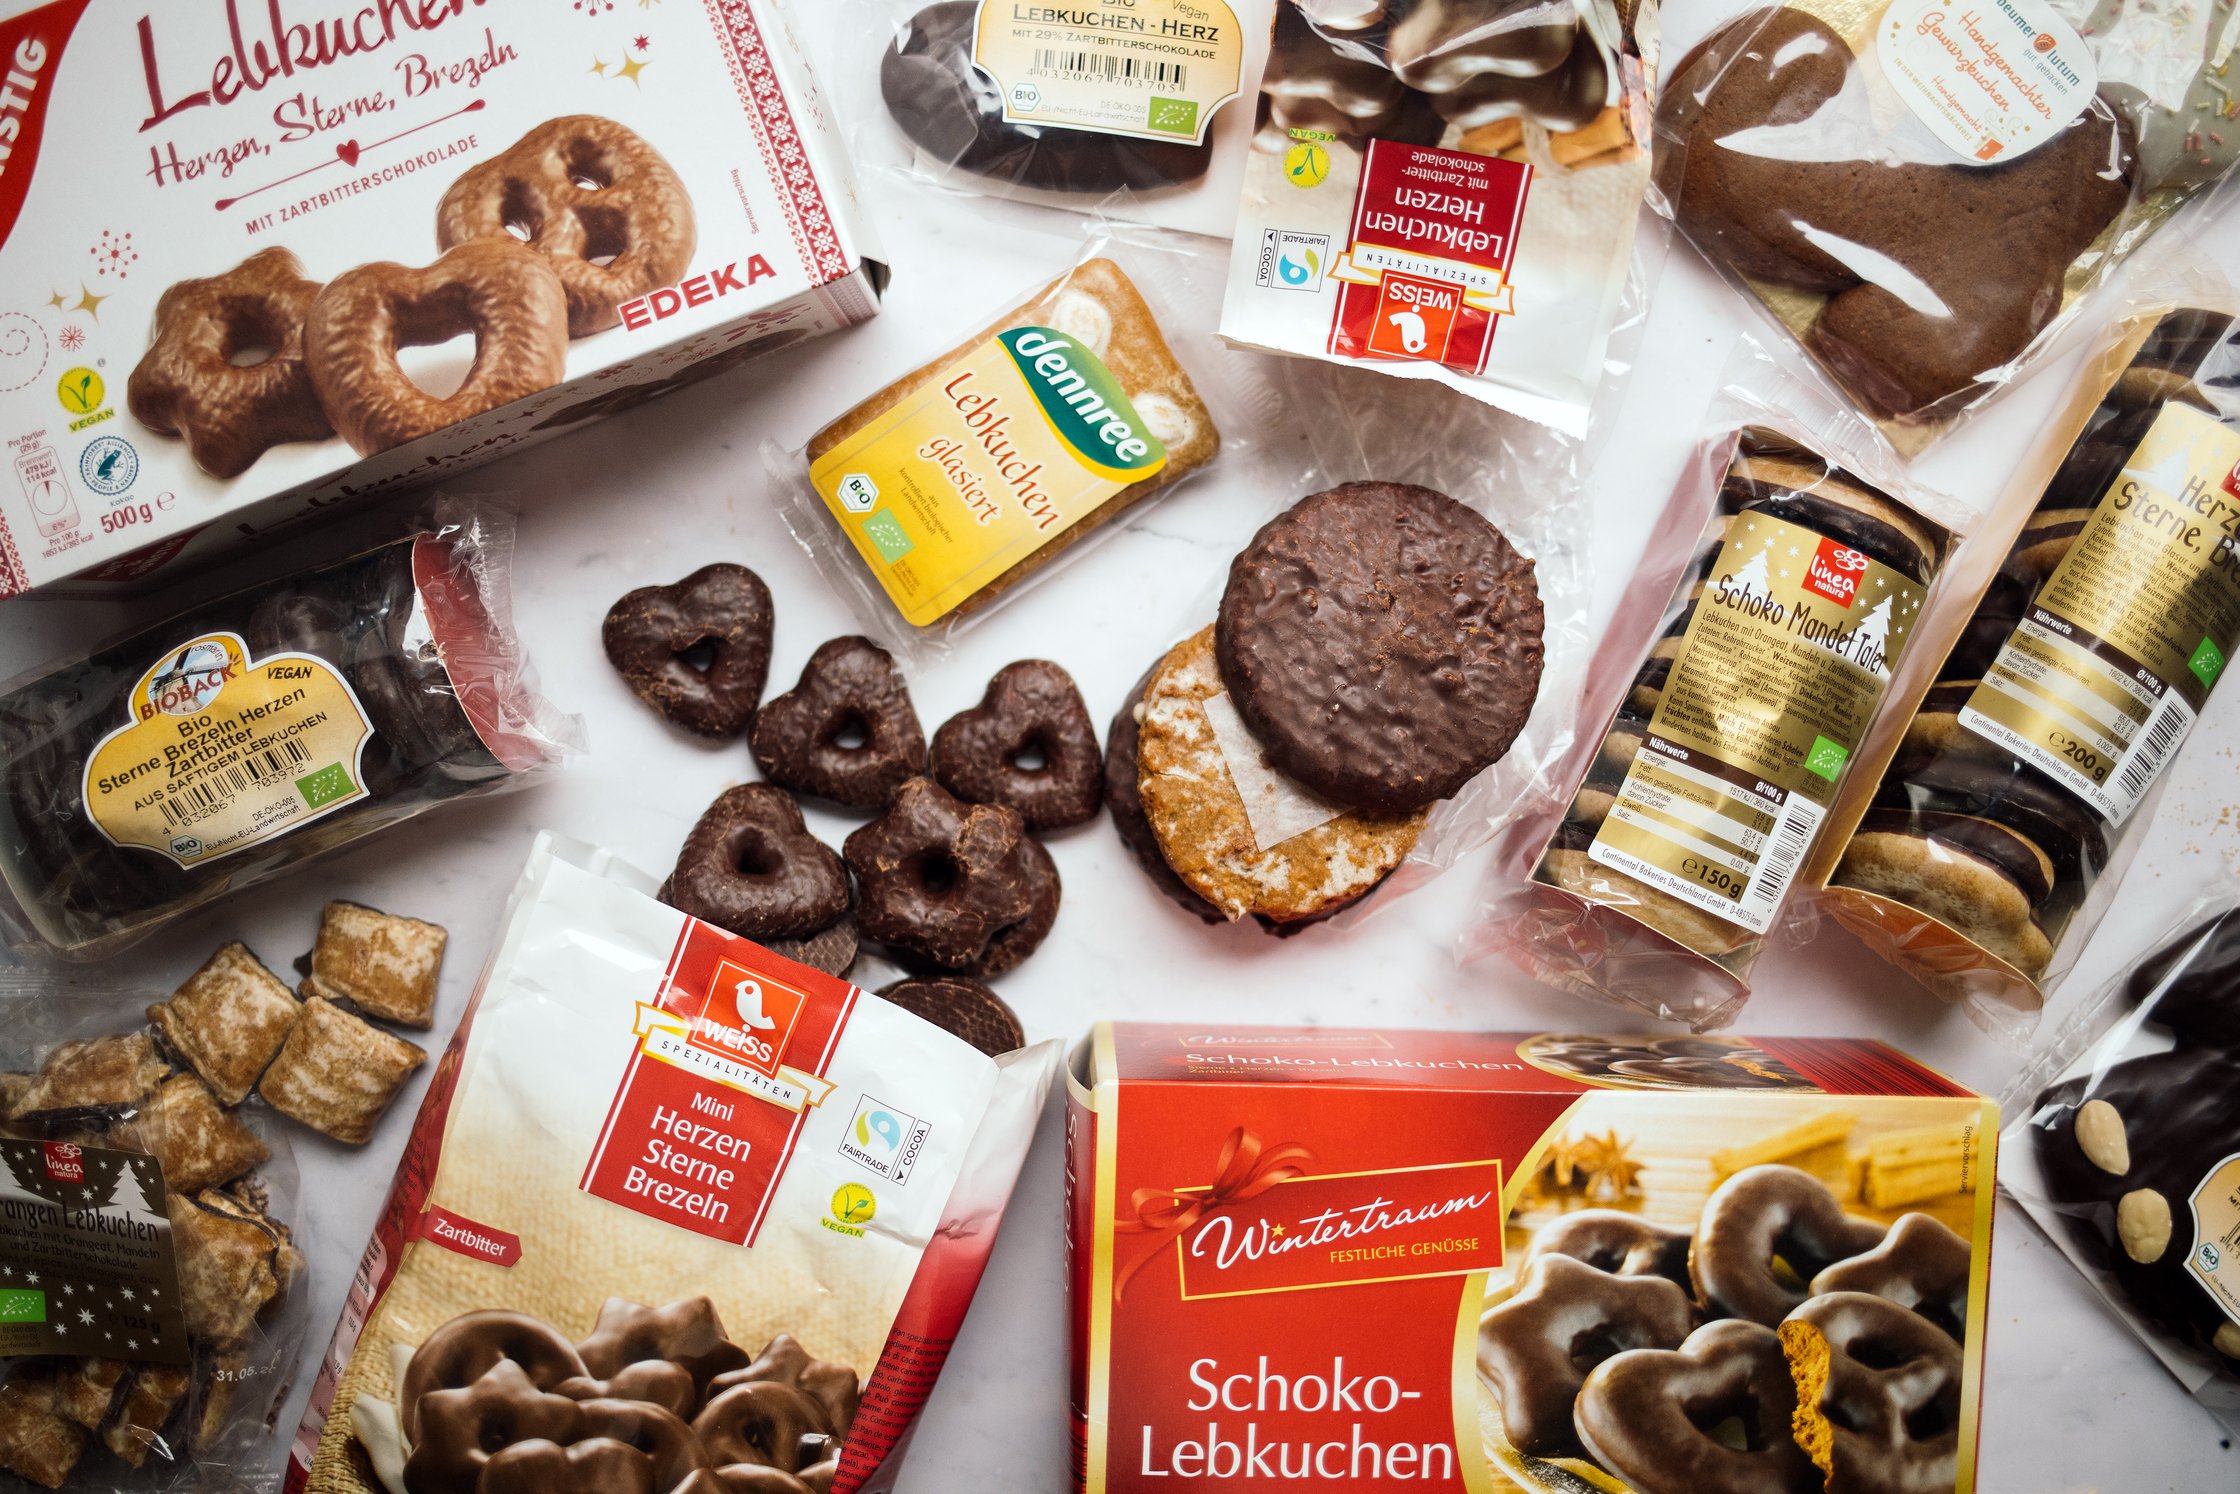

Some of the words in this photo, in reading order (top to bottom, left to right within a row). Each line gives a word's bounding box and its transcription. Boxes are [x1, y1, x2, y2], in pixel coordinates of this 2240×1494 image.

[1172, 0, 1210, 22] Vegan
[1036, 29, 1063, 40] 29%
[1997, 0, 2036, 39] beumer
[2046, 50, 2081, 87] lutum
[1916, 12, 2010, 112] Gewürzkuchen
[1958, 11, 2053, 120] Handgemachter
[2021, 47, 2038, 63] gut
[2035, 61, 2069, 96] gebacken
[1040, 69, 1103, 83] 032067
[1115, 77, 1175, 93] 703705
[146, 142, 271, 186] Herzen,
[274, 93, 395, 142] Sterne,
[396, 28, 518, 97] Brezeln
[1931, 75, 1984, 133] Handgemacht
[1289, 128, 1336, 142] VEGAN
[1401, 167, 1463, 188] Zartbitter-
[1411, 152, 1485, 173] schokolade
[246, 213, 274, 235] MIT
[280, 135, 479, 222] ZARTBITTERSCHOKOLADE
[731, 169, 759, 234] Serviervorschlag
[1468, 176, 1489, 191] mit
[1395, 187, 1485, 224] Herzen
[1282, 234, 1326, 245] FAIRTRADE
[1365, 210, 1503, 258] Lebkuchen
[1259, 246, 1272, 281] COCOA
[1367, 253, 1486, 285] SPEZIALITÄTEN
[617, 253, 778, 331] EDEKA
[1015, 332, 1148, 462] dennree
[70, 408, 115, 432] VEGAN
[8, 439, 19, 448] Pro
[21, 430, 47, 443] Portion
[944, 371, 1059, 530] Lebkuchen
[19, 451, 52, 468] Brennwert
[26, 464, 39, 474] 479
[27, 473, 40, 483] 114
[42, 467, 57, 478] kcal
[85, 441, 105, 476] RAINFOREST
[107, 441, 134, 460] ALLIANCE
[920, 436, 999, 524] glasiert
[101, 506, 137, 534] 500
[139, 503, 153, 523] g
[110, 495, 134, 507] Kakao
[898, 467, 927, 505] kontrolliert
[923, 503, 954, 544] biologischer
[899, 486, 936, 536] Landwirtschaft
[928, 494, 939, 507] aus
[2114, 481, 2202, 553] Sterne,
[2100, 511, 2145, 543] Lebkuchen
[2160, 543, 2190, 566] Glasur
[1810, 555, 1855, 594] linea
[1814, 578, 1845, 599] natura
[1701, 606, 1741, 635] Lebkuchen
[1739, 624, 1754, 638] mit
[1752, 628, 1790, 655] Orangeat,
[1789, 642, 1822, 666] Mandeln
[1714, 574, 1784, 625] Schoko
[1787, 602, 1856, 657] Mandel
[1856, 633, 1888, 675] Taler
[2032, 608, 2073, 636] Nährwerte
[2006, 648, 2049, 677] Kohlenhydrate:
[2013, 639, 2032, 654] davon
[2024, 622, 2049, 640] Energie:
[2107, 667, 2124, 682] 1602
[267, 666, 312, 680] VEGAN
[2002, 656, 2021, 671] davon
[2018, 664, 2042, 682] Zucker:
[140, 663, 238, 721] BIOBACK
[1686, 687, 1720, 709] kontrolliert
[177, 714, 212, 738] Bio
[1661, 717, 1691, 736] Mindestens
[1663, 703, 1692, 723] früchten
[99, 755, 161, 795] Sterne
[164, 716, 236, 763] Brezeln
[238, 687, 306, 725] Herzen
[166, 726, 253, 778] Zartbitter
[1647, 736, 1689, 762] Nährwerte
[1969, 713, 2006, 739] Continental
[2002, 731, 2033, 754] Bakeries
[2029, 747, 2072, 779] Deutschland
[2067, 772, 2089, 791] GmbH
[134, 790, 164, 811] AUS
[168, 751, 241, 794] SAFTIGEM
[245, 711, 327, 756] LEBKUCHEN
[1642, 751, 1668, 769] Energie:
[1728, 786, 1743, 798] 1517
[2060, 738, 2100, 771] 200
[2090, 763, 2108, 783] g
[162, 826, 171, 835] 4
[182, 794, 236, 827] 032067
[252, 763, 306, 790] 703972
[1626, 788, 1645, 802] davon
[1644, 795, 1666, 811] Zucker:
[1629, 779, 1673, 805] Kohlenhydrate:
[1635, 769, 1655, 783] davon
[1652, 776, 1682, 797] gesättigte
[1681, 788, 1715, 809] Fettsäuren:
[1615, 807, 1631, 821] Salz:
[1728, 857, 1743, 870] 0,03
[1601, 847, 1640, 872] Continental
[1638, 864, 1668, 884] Bakeries
[1666, 877, 1707, 902] Deutschland
[1705, 894, 1727, 911] GmbH
[1697, 864, 1732, 890] 150
[1727, 880, 1743, 899] g
[661, 1040, 792, 1100] SPEZIALITÄTEN
[1187, 1053, 1524, 1071] Schoko-Lebkuchen
[690, 1092, 735, 1122] Mini
[650, 1105, 753, 1163] Herzen
[903, 1129, 926, 1166] COCOA
[46, 1156, 83, 1174] linea
[54, 1170, 78, 1179] natura
[642, 1139, 736, 1192] Sterne
[843, 1144, 889, 1173] FAIRTRADE
[1959, 1126, 1973, 1194] Serviervorschlag
[623, 1165, 729, 1224] Brezeln
[0, 1201, 58, 1229] angen
[63, 1200, 159, 1242] Lebkuchen
[434, 1217, 507, 1257] Zartbitter
[821, 1219, 865, 1238] VEGAN
[1192, 1190, 1492, 1271] Wintertraum
[11, 1241, 29, 1250] und
[33, 1241, 138, 1270] Zartbitterschokolade
[44, 1231, 60, 1241] mit
[117, 1243, 160, 1258] Mandeln
[1329, 1244, 1407, 1264] FESTLICHE
[1411, 1236, 1479, 1256] GENÜSSE
[123, 1315, 147, 1329] 125
[1188, 1355, 1421, 1414] Schoko-
[1141, 1423, 1453, 1480] Lebkuchen
